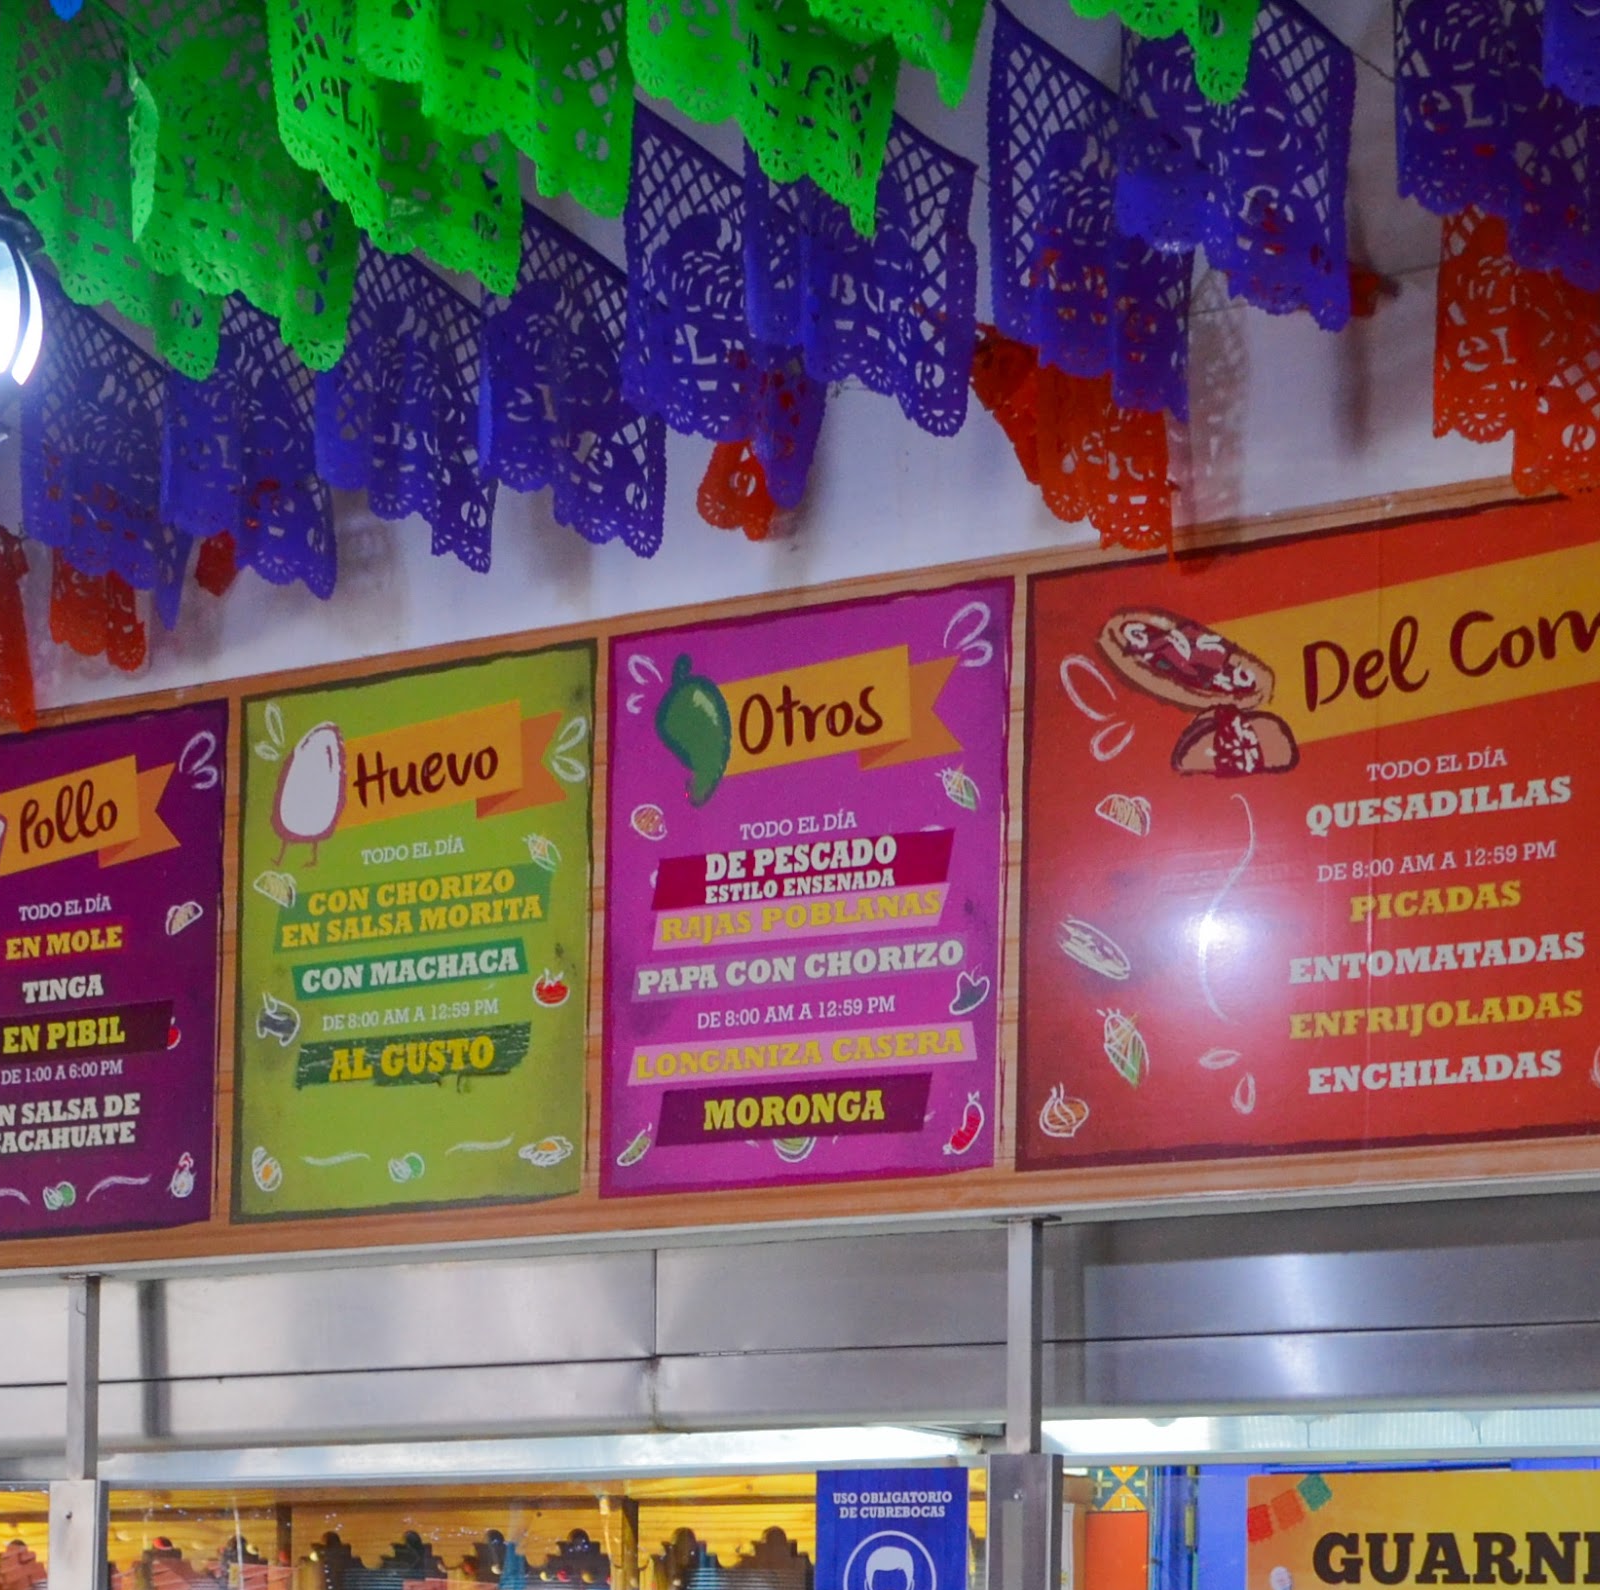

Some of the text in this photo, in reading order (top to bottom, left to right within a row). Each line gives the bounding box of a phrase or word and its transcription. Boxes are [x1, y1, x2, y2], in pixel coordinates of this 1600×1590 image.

[1301, 614, 1431, 713] Del
[737, 684, 884, 756] Otros
[353, 744, 500, 809] Huevo
[1366, 745, 1509, 783] TODO EL DÍA
[20, 778, 118, 854] Pollo
[740, 807, 858, 841] TODO EL DÍA
[1304, 775, 1573, 838] QUESADILLAS
[361, 834, 466, 866] TODO EL DÍA
[705, 835, 898, 882] DE PESCADO
[19, 894, 112, 922] TODO EL DÍA
[307, 869, 516, 918] CON CHORIZO
[705, 869, 896, 905] ESTILO ENSENADA
[1349, 880, 1523, 924] PICADAS
[280, 894, 543, 950] EN SALSA MORITA
[660, 889, 942, 946] RAJAS POBLANAS
[5, 925, 123, 962] EN MOLE
[1289, 930, 1587, 986] ENTOMATADAS
[22, 974, 104, 1004] TINGA
[301, 945, 520, 994] CON MACHACA
[637, 939, 966, 996] PAPA CON CHORIZO
[2, 1017, 126, 1054] EN PIBIL
[696, 994, 897, 1030] DE 8:00 AM A 12:59 PM
[1289, 989, 1586, 1042] ENFRIJOLADAS
[1, 1060, 124, 1085] DE 1:00 A 6:00 PM
[328, 1035, 496, 1082] AL GUSTO
[635, 1028, 965, 1080] LONGANIZA CASERA
[1307, 1049, 1564, 1096] ENCHILADAS
[20, 1096, 98, 1126] SALSA
[103, 1093, 141, 1119] DE
[703, 1089, 886, 1131] MORONGA
[833, 1491, 952, 1504] USO OBLIGATORIO
[839, 1506, 945, 1518] DE CUBREBOCAS
